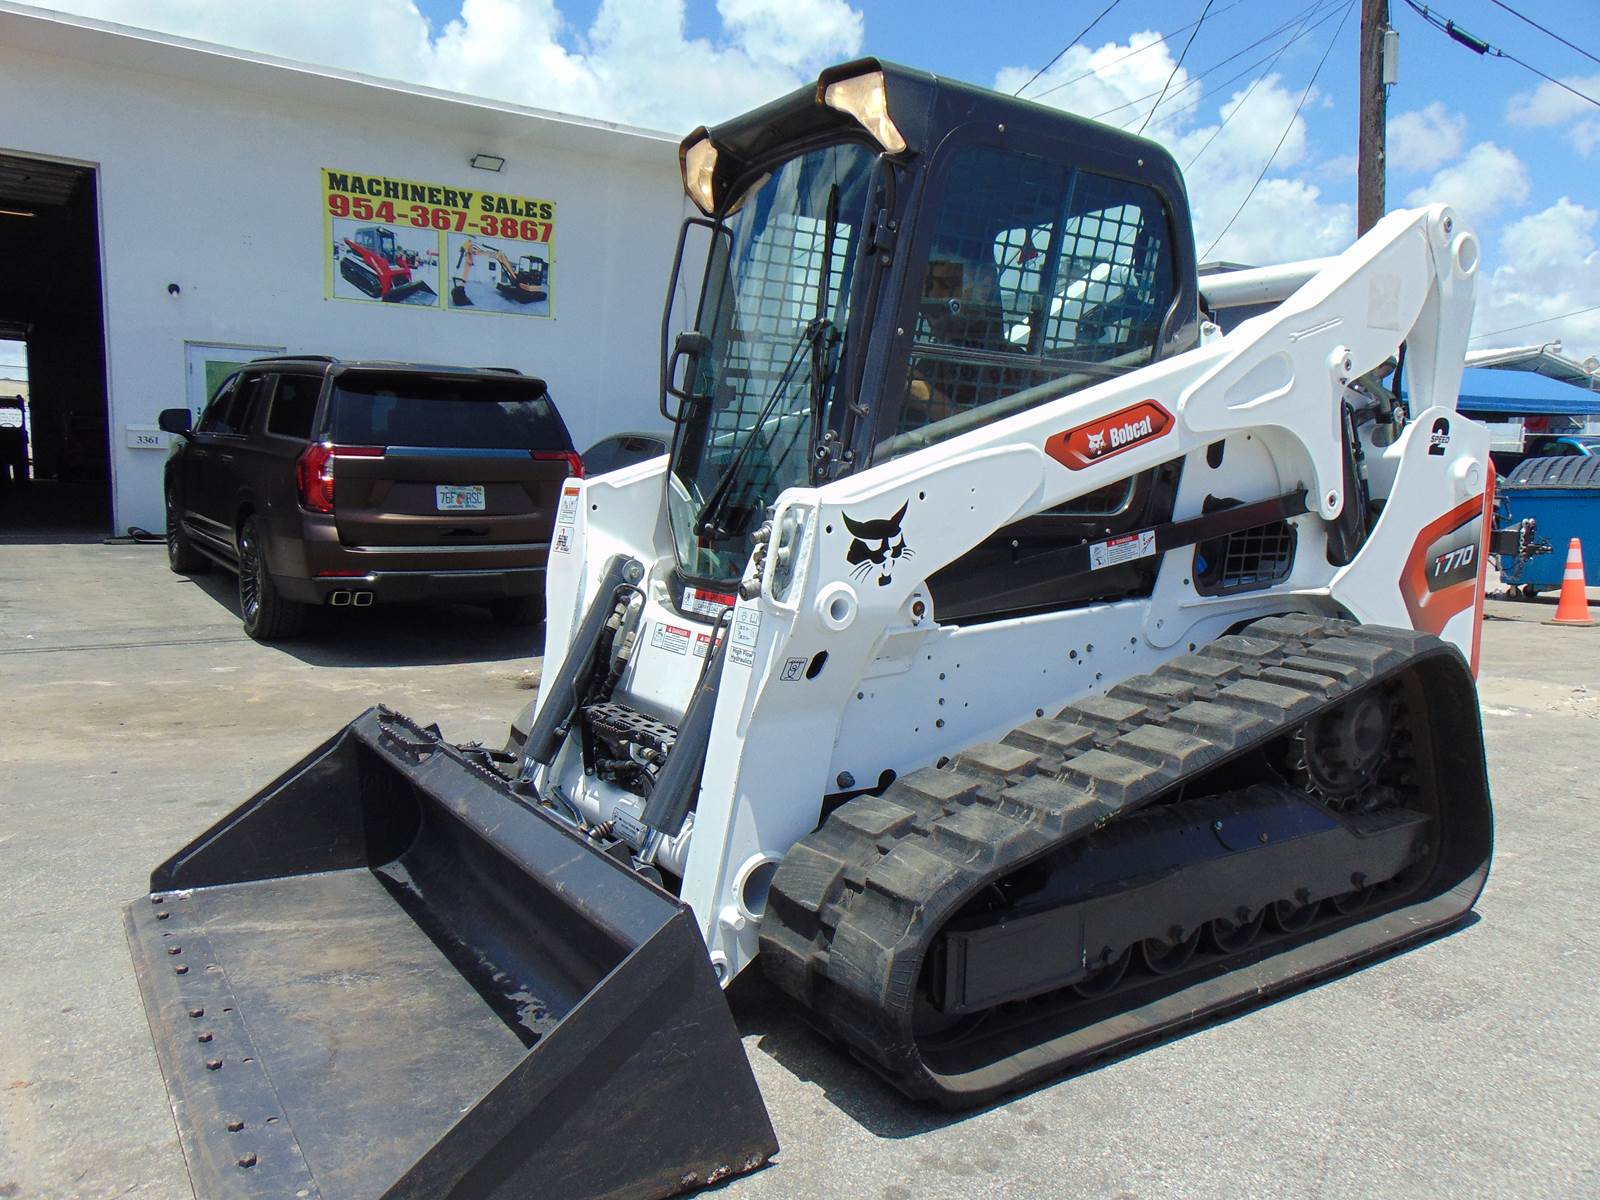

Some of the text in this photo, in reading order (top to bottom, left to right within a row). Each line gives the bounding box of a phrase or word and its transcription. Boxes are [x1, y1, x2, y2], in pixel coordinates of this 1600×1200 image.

[328, 172, 553, 220] MACHINERY SALES
[328, 193, 553, 243] 954-367-3867
[137, 435, 159, 445] 3361
[1109, 415, 1152, 448] Bobcat
